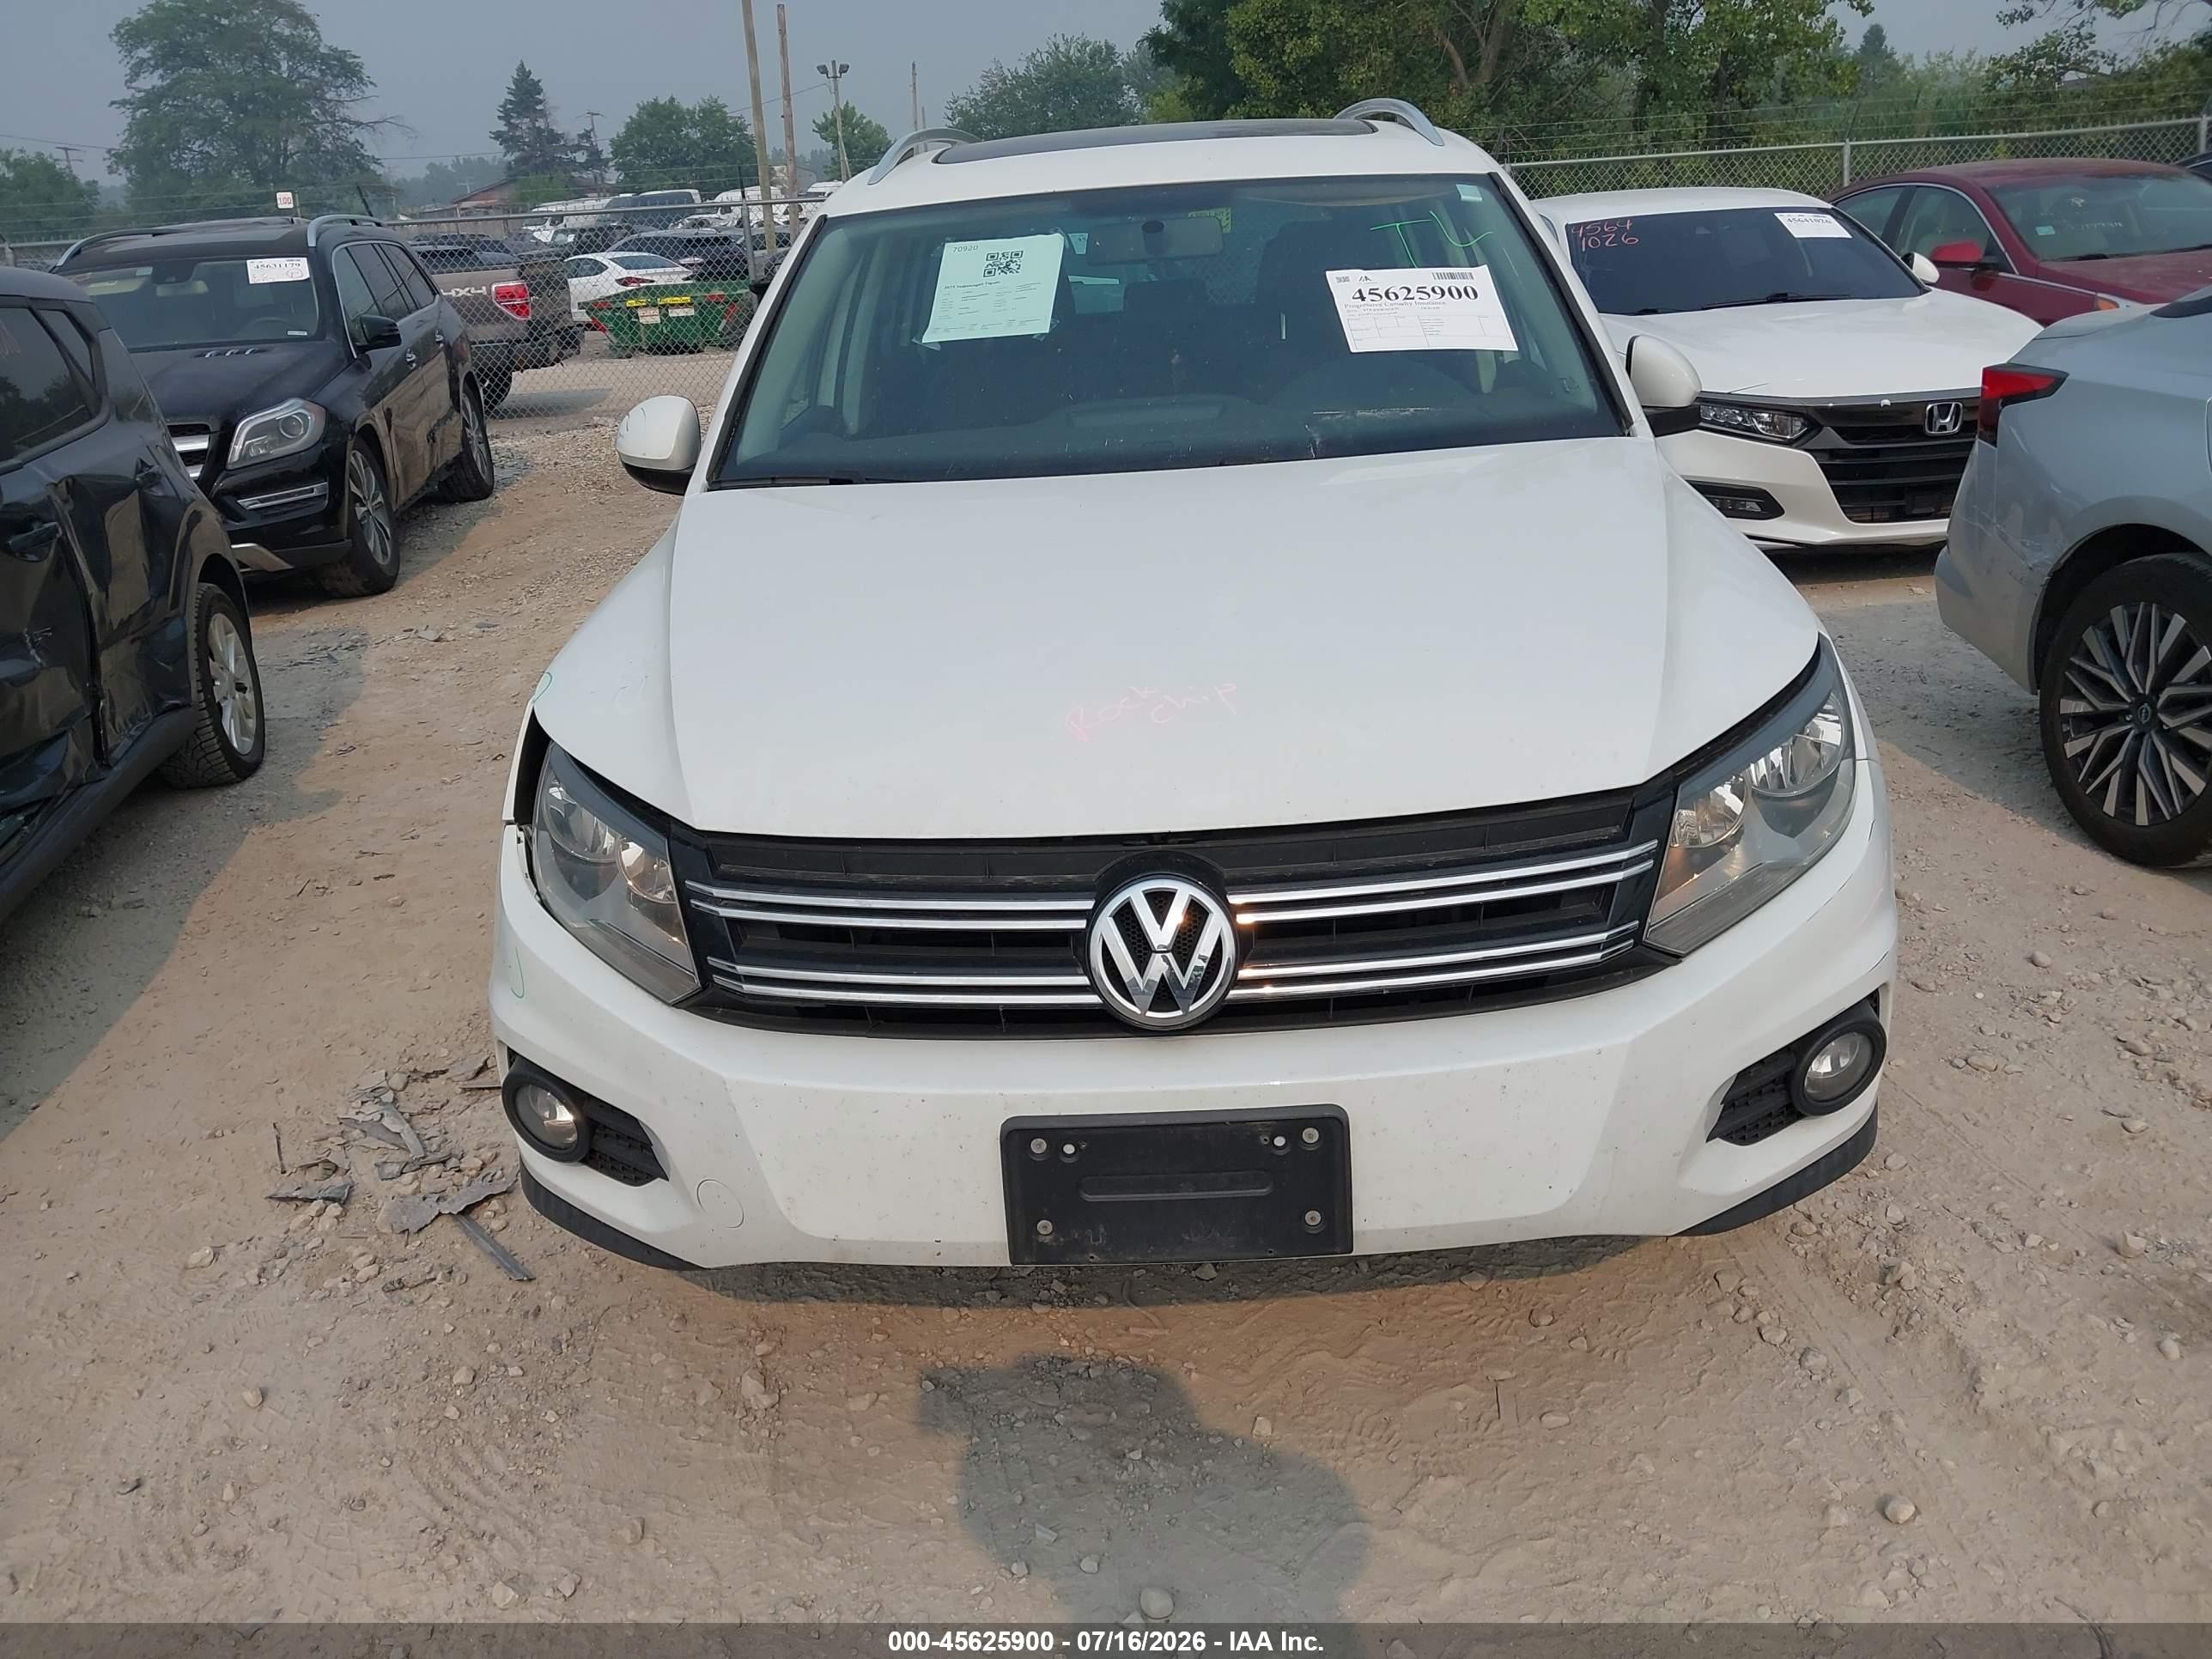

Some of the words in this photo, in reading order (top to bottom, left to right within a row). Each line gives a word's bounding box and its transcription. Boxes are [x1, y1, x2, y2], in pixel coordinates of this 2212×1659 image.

[1571, 218, 1633, 238] 4564
[1582, 232, 1641, 252] 1026
[1352, 284, 1479, 303] 45625900
[1090, 878, 1237, 1027] VW
